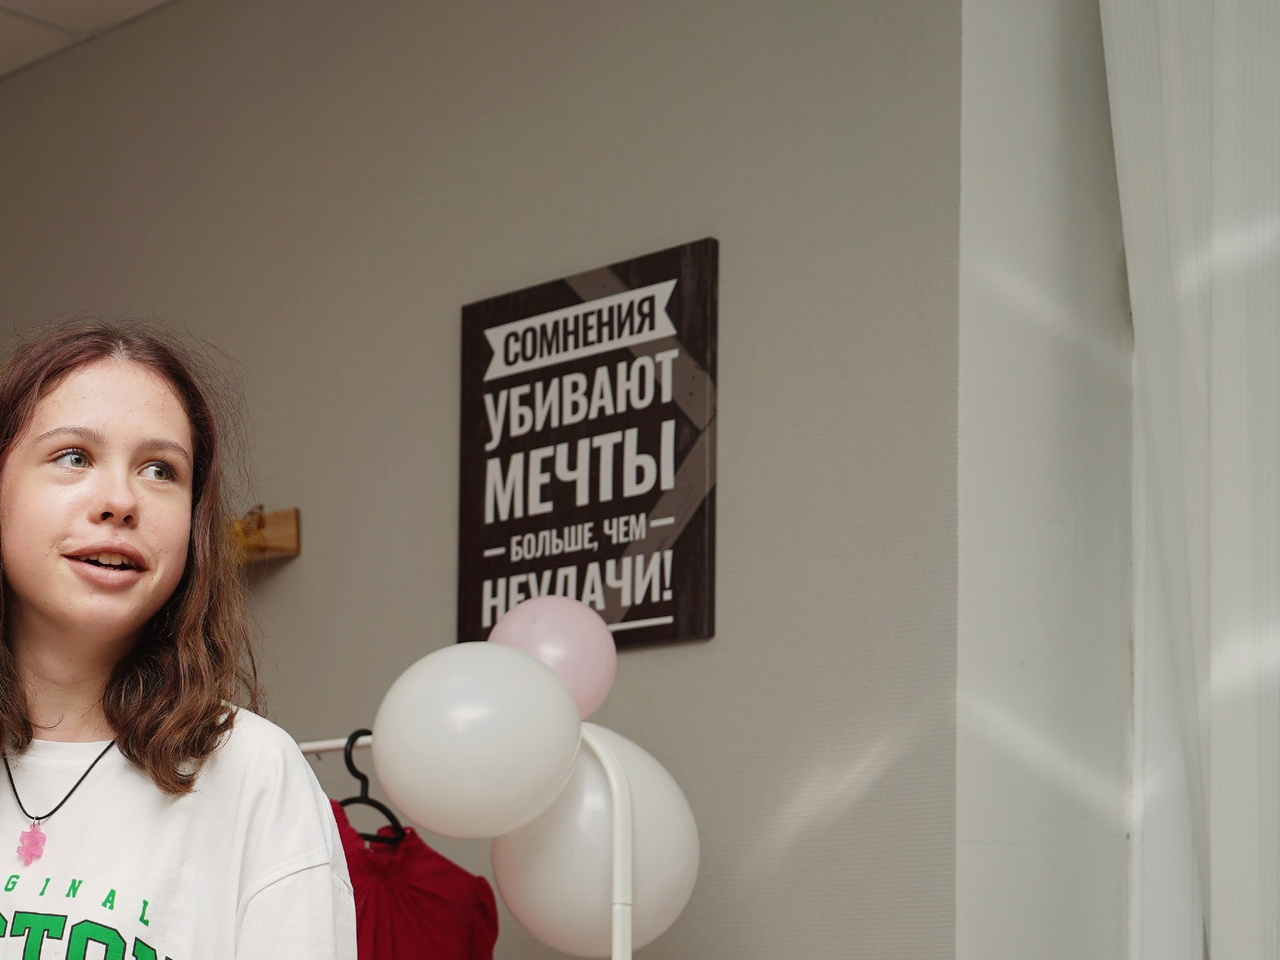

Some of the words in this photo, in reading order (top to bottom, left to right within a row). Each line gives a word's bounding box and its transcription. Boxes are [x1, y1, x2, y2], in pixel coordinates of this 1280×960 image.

[503, 295, 656, 366] СОМНЕНИЯ
[484, 348, 679, 452] УБИВАЮТ
[484, 419, 677, 525] МЕЧТЫ
[510, 522, 599, 563] БОЛЬШЕ,
[604, 512, 647, 545] ЧЕМ
